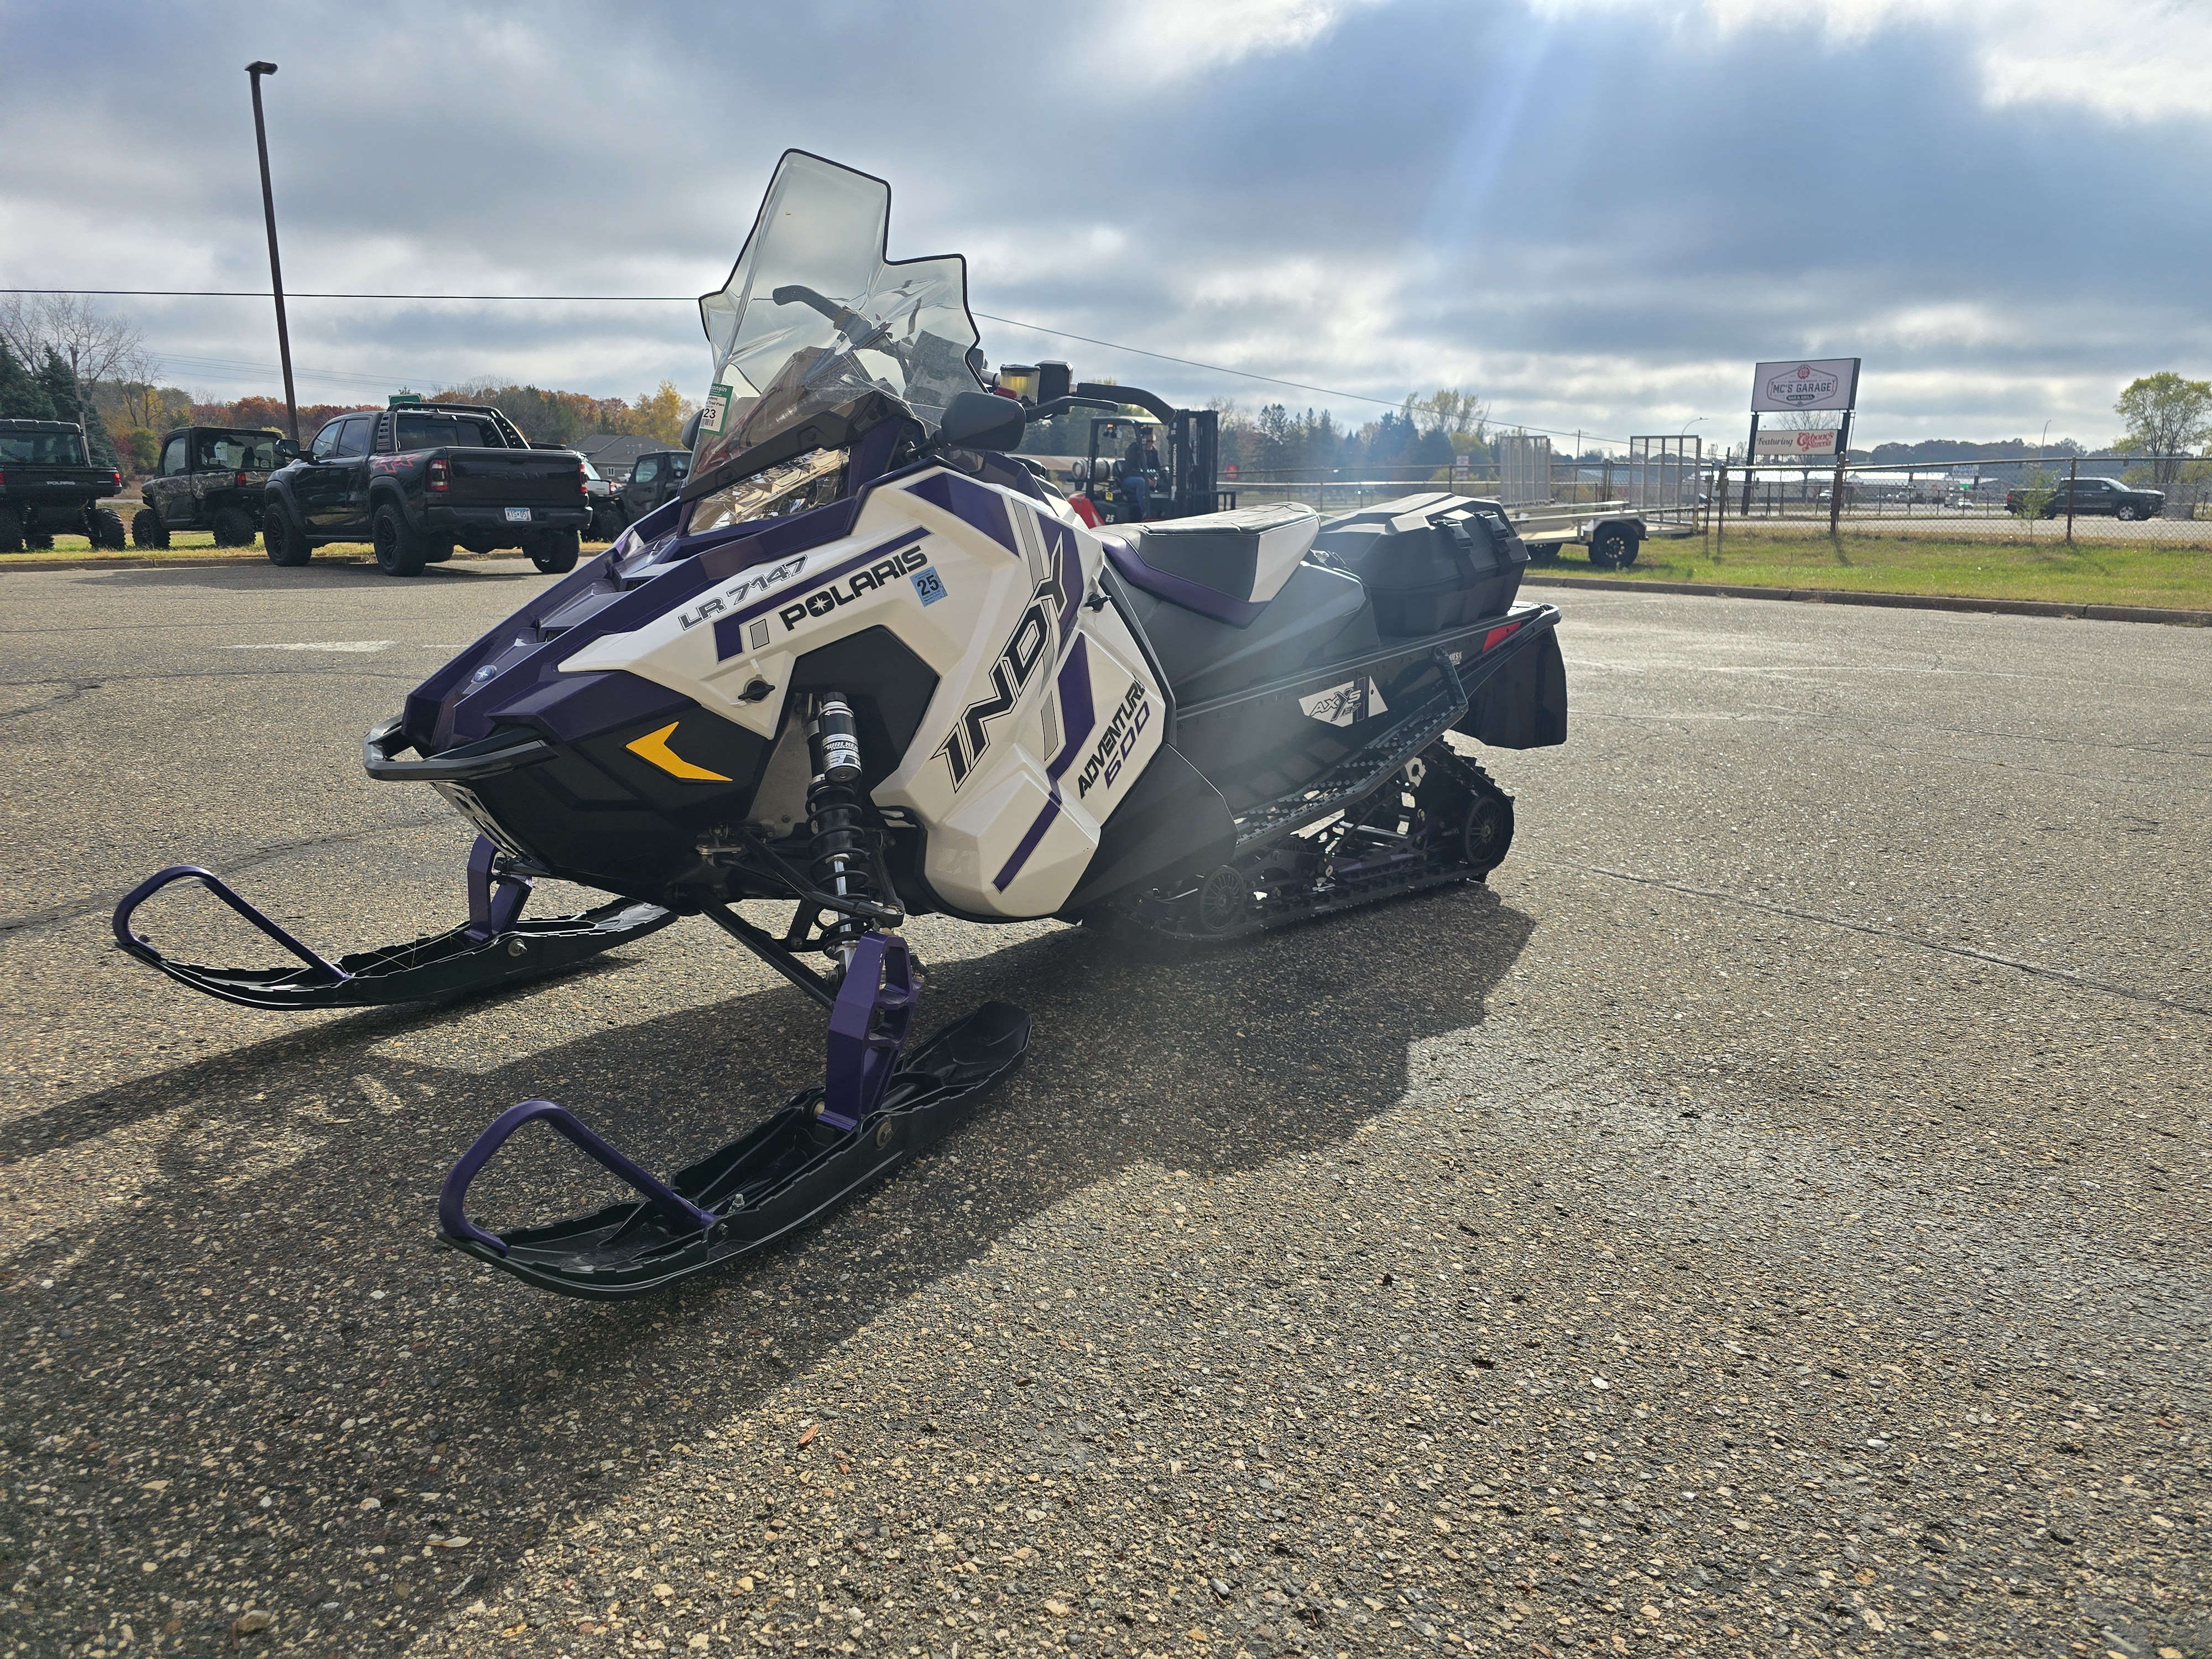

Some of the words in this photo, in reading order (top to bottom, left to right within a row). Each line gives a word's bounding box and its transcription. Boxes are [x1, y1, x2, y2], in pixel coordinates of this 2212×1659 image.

[1773, 384, 1793, 393] MC'S
[1796, 382, 1832, 393] GARAGE
[703, 408, 716, 419] 23
[1757, 437, 1793, 447] Featuring
[678, 597, 726, 631] LR
[726, 555, 808, 605] 7147
[779, 545, 928, 632] POLARIS
[917, 574, 939, 596] 25
[930, 530, 1068, 794] INDY
[1104, 700, 1150, 790] 600
